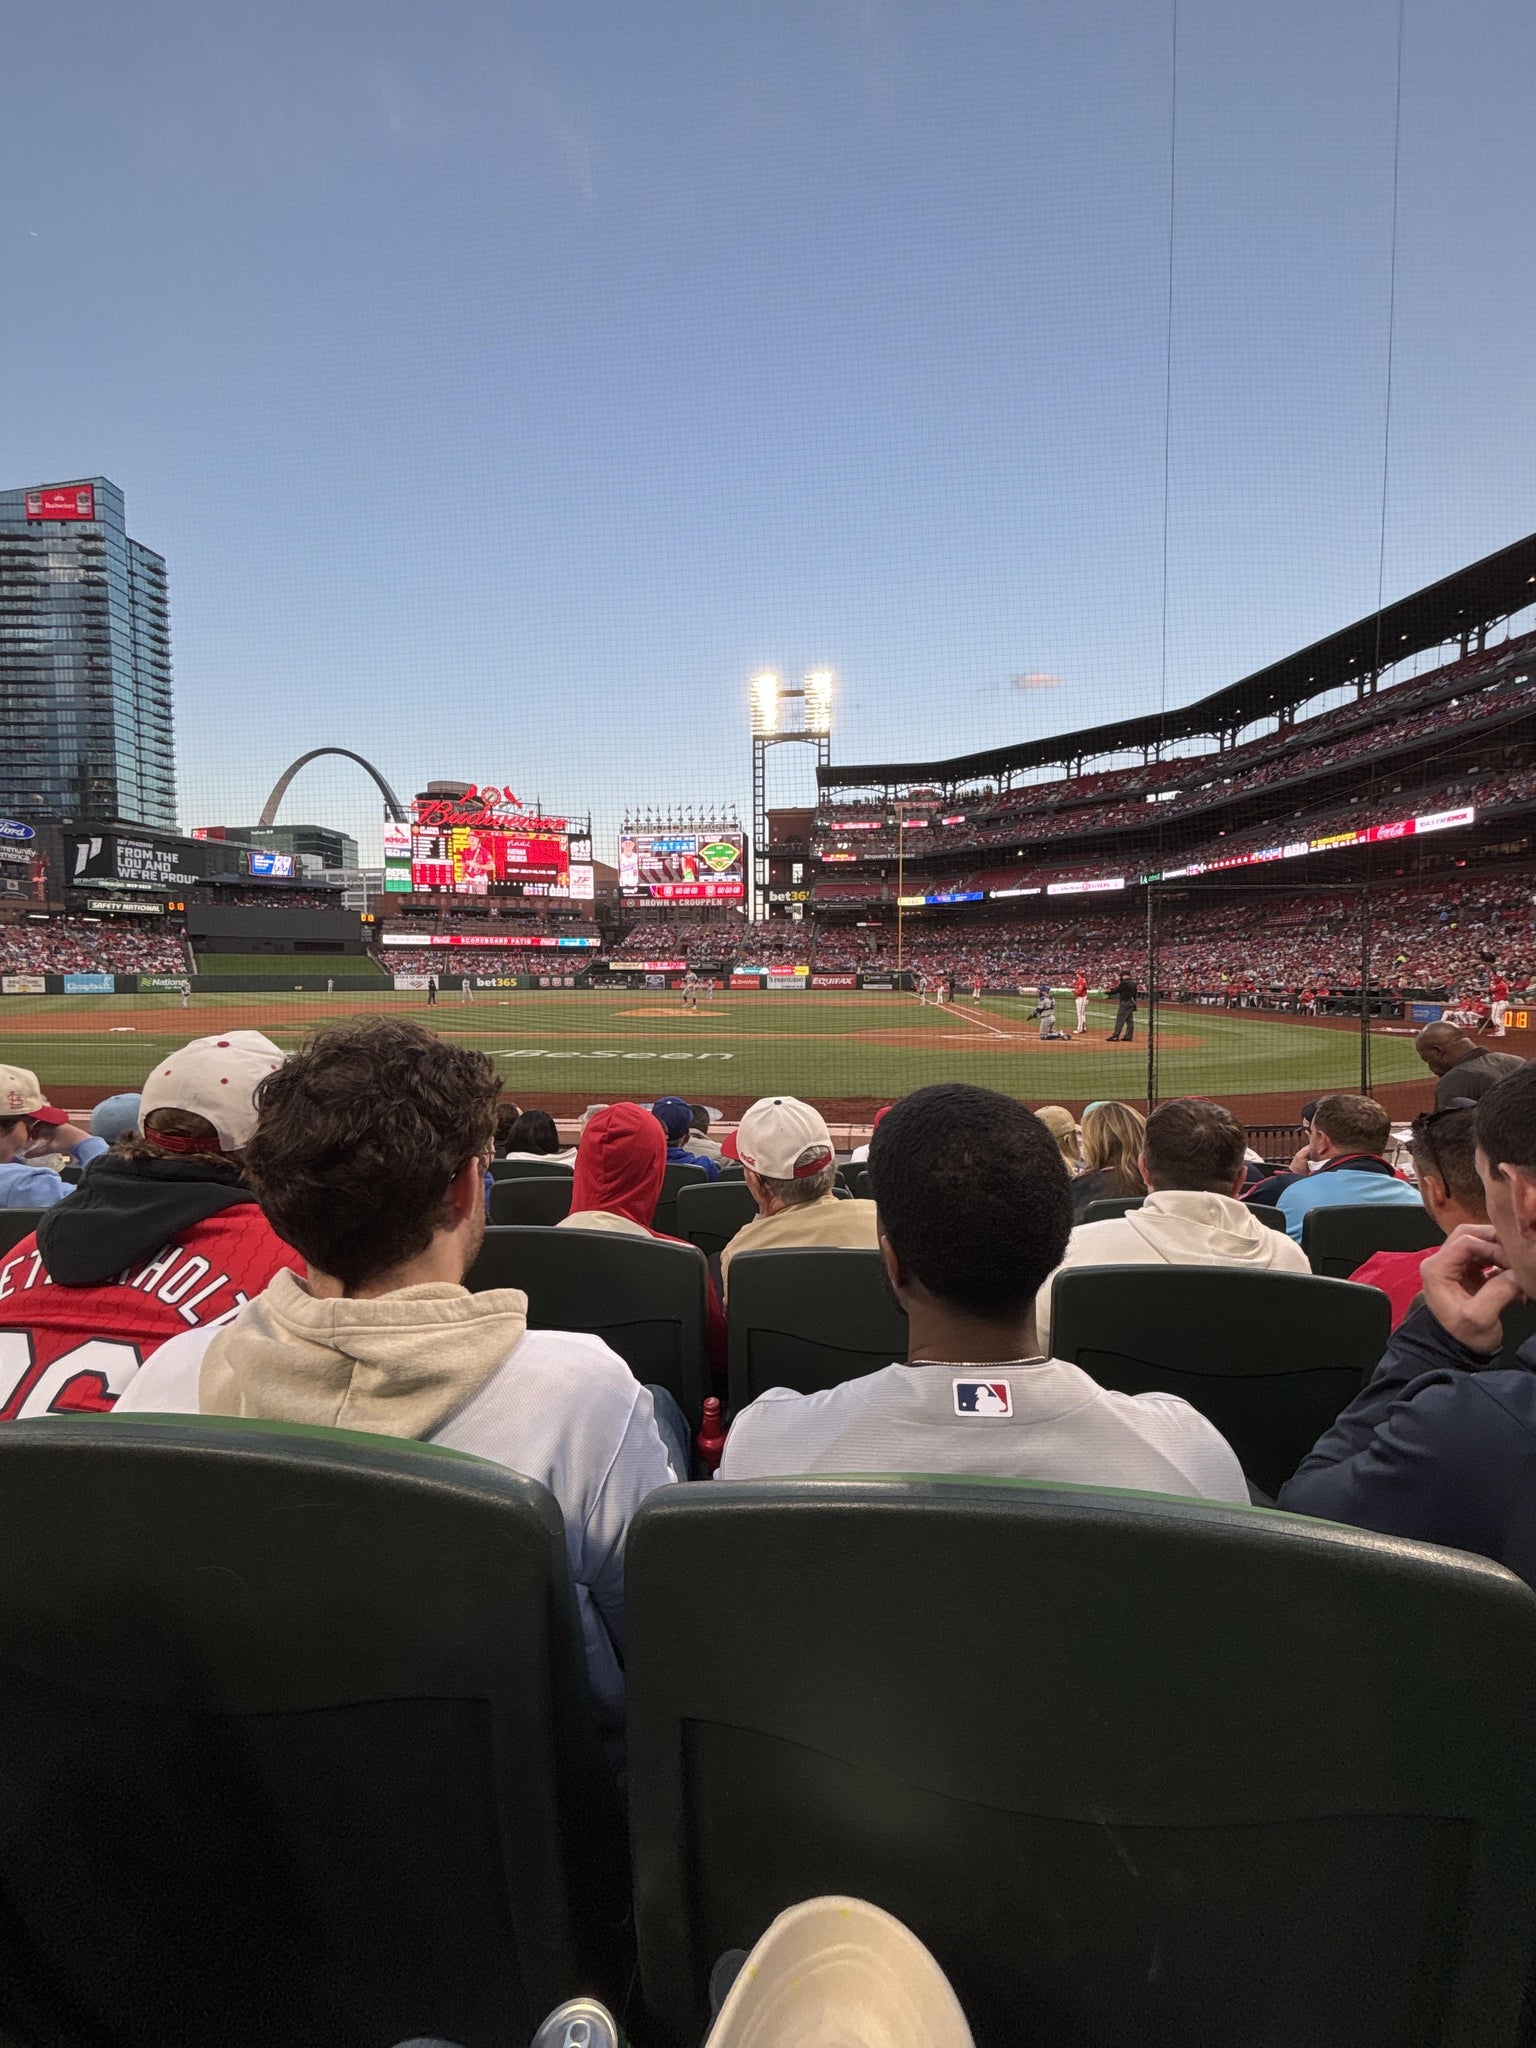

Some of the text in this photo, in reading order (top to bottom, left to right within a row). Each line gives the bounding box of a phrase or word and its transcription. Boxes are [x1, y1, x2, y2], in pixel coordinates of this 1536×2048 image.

[411, 799, 568, 831] Budweiser
[0, 823, 26, 837] Ford
[385, 836, 410, 844] KMOX
[0, 845, 36, 858] mmunity
[570, 840, 591, 853] stl
[0, 853, 30, 861] merica
[117, 846, 179, 863] FROM THE
[117, 857, 171, 873] LOU AND
[117, 867, 158, 881] WE'RE
[123, 903, 161, 912] NATIONAL
[640, 899, 670, 907] BROWN
[679, 899, 723, 907] CROUPPEN
[461, 935, 509, 945] SCOREBOARD
[511, 937, 532, 945] PATIO
[476, 977, 518, 987] bet365
[813, 977, 852, 985] EQUIFAX
